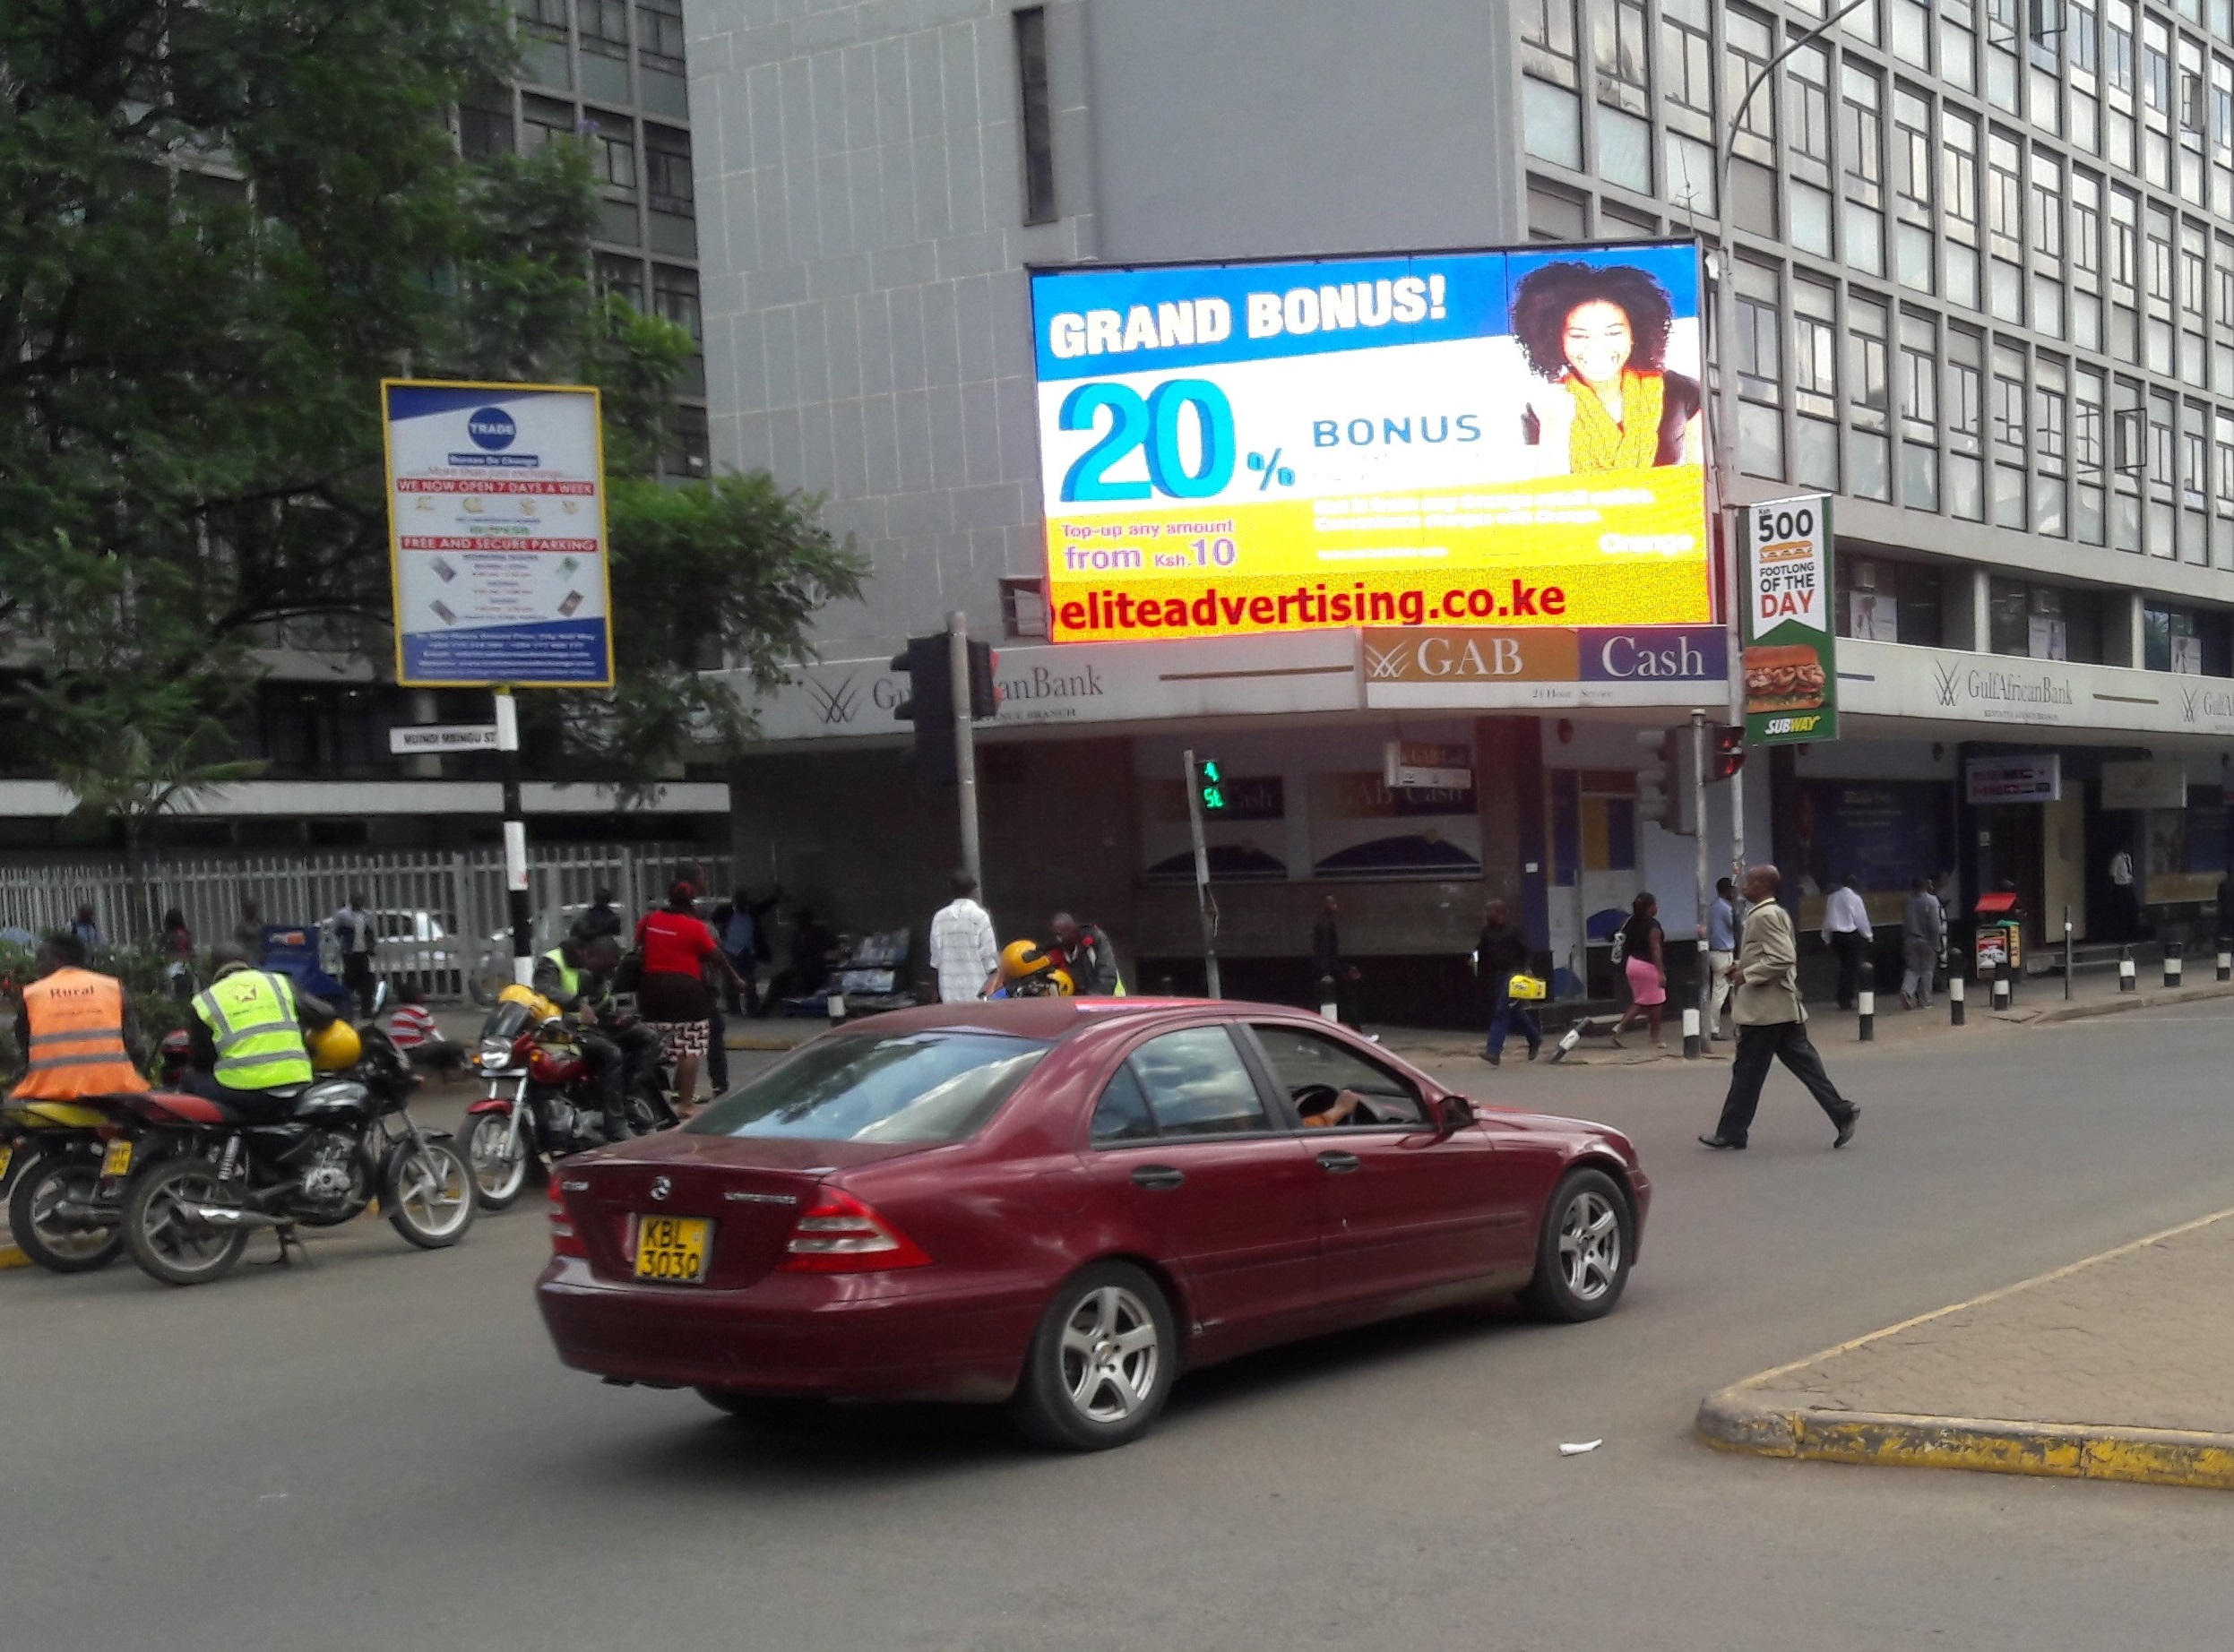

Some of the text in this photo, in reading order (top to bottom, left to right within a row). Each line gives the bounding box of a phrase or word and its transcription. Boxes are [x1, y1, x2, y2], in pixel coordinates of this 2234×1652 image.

[1049, 274, 1447, 359] GRAND BONUS!
[470, 422, 515, 435] TRADE
[1058, 379, 1236, 502] 20
[1313, 415, 1481, 447] BONUS
[399, 479, 418, 491] WE
[421, 479, 453, 492] NOW
[458, 480, 493, 492] OPEN
[497, 481, 505, 493] 7
[509, 481, 541, 493] DAYS
[558, 482, 593, 495] WEEK
[1061, 519, 1235, 539] Top-up any amount
[1759, 509, 1813, 542] 500
[403, 538, 598, 552] FREE AND SECURE PARKING
[1065, 546, 1141, 570] from
[1760, 562, 1815, 577] FOOTLONG
[1760, 573, 1815, 592] OF THE
[1050, 579, 1566, 629] eliteadvertising.co.ke
[1761, 589, 1815, 618] DAY
[1417, 635, 1706, 677] GAB Cash
[1764, 715, 1822, 735] SUBWAY
[49, 985, 95, 1000] Rural
[643, 1220, 687, 1250] KBL
